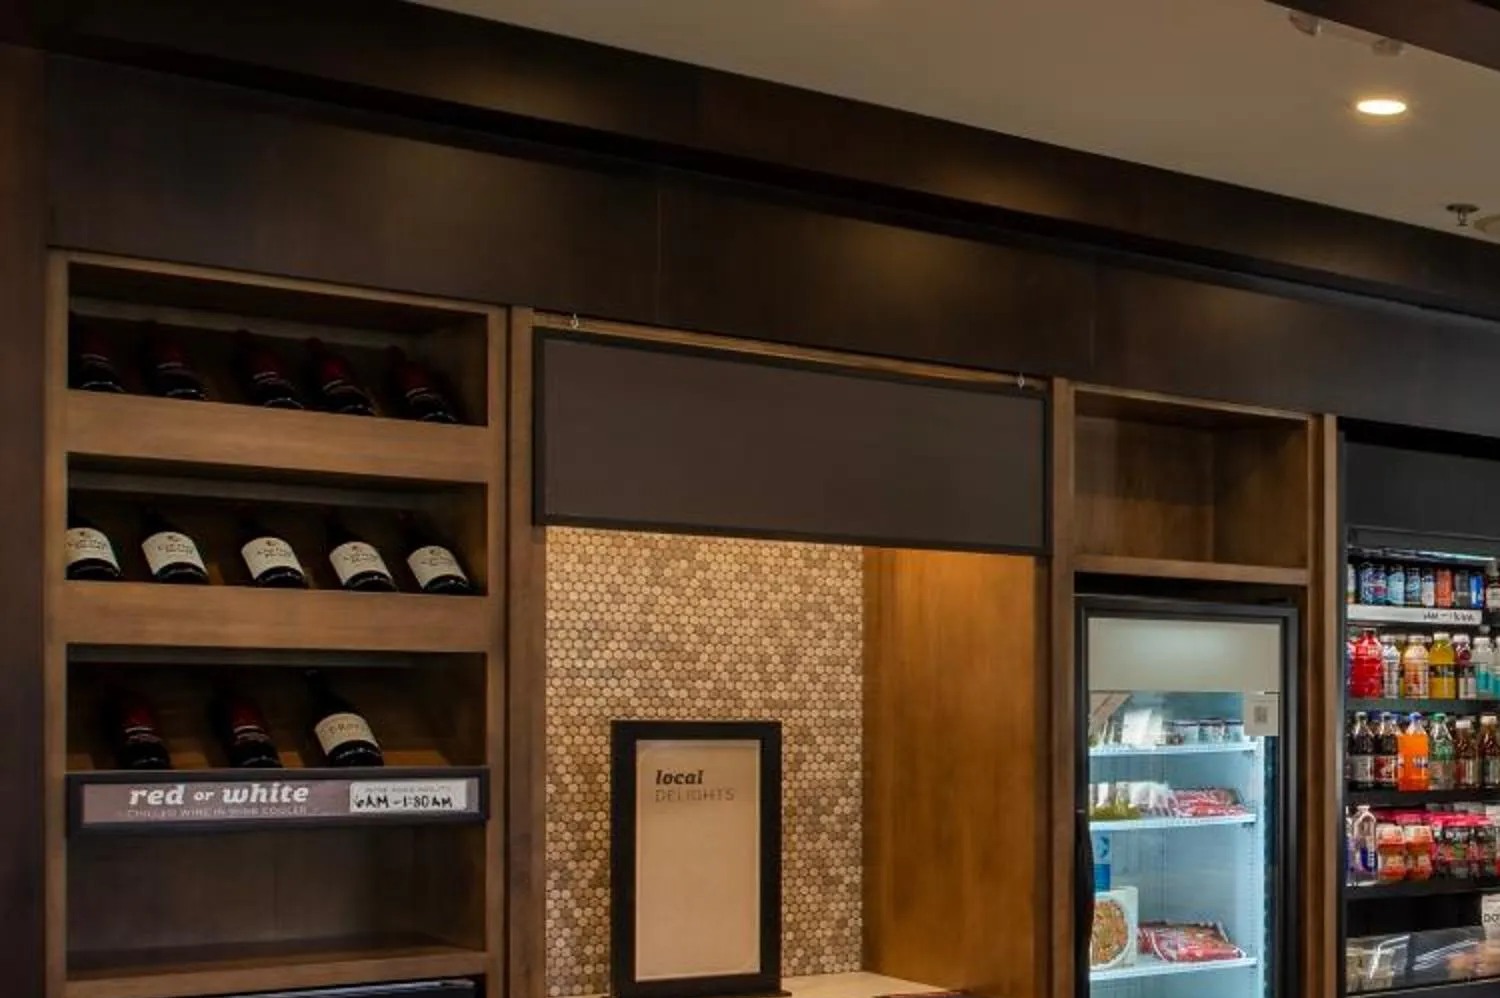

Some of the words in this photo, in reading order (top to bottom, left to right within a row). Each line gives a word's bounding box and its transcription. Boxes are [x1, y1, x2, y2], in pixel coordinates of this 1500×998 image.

[655, 769, 704, 785] local
[128, 784, 186, 806] red
[193, 790, 214, 801] or
[222, 781, 309, 804] white
